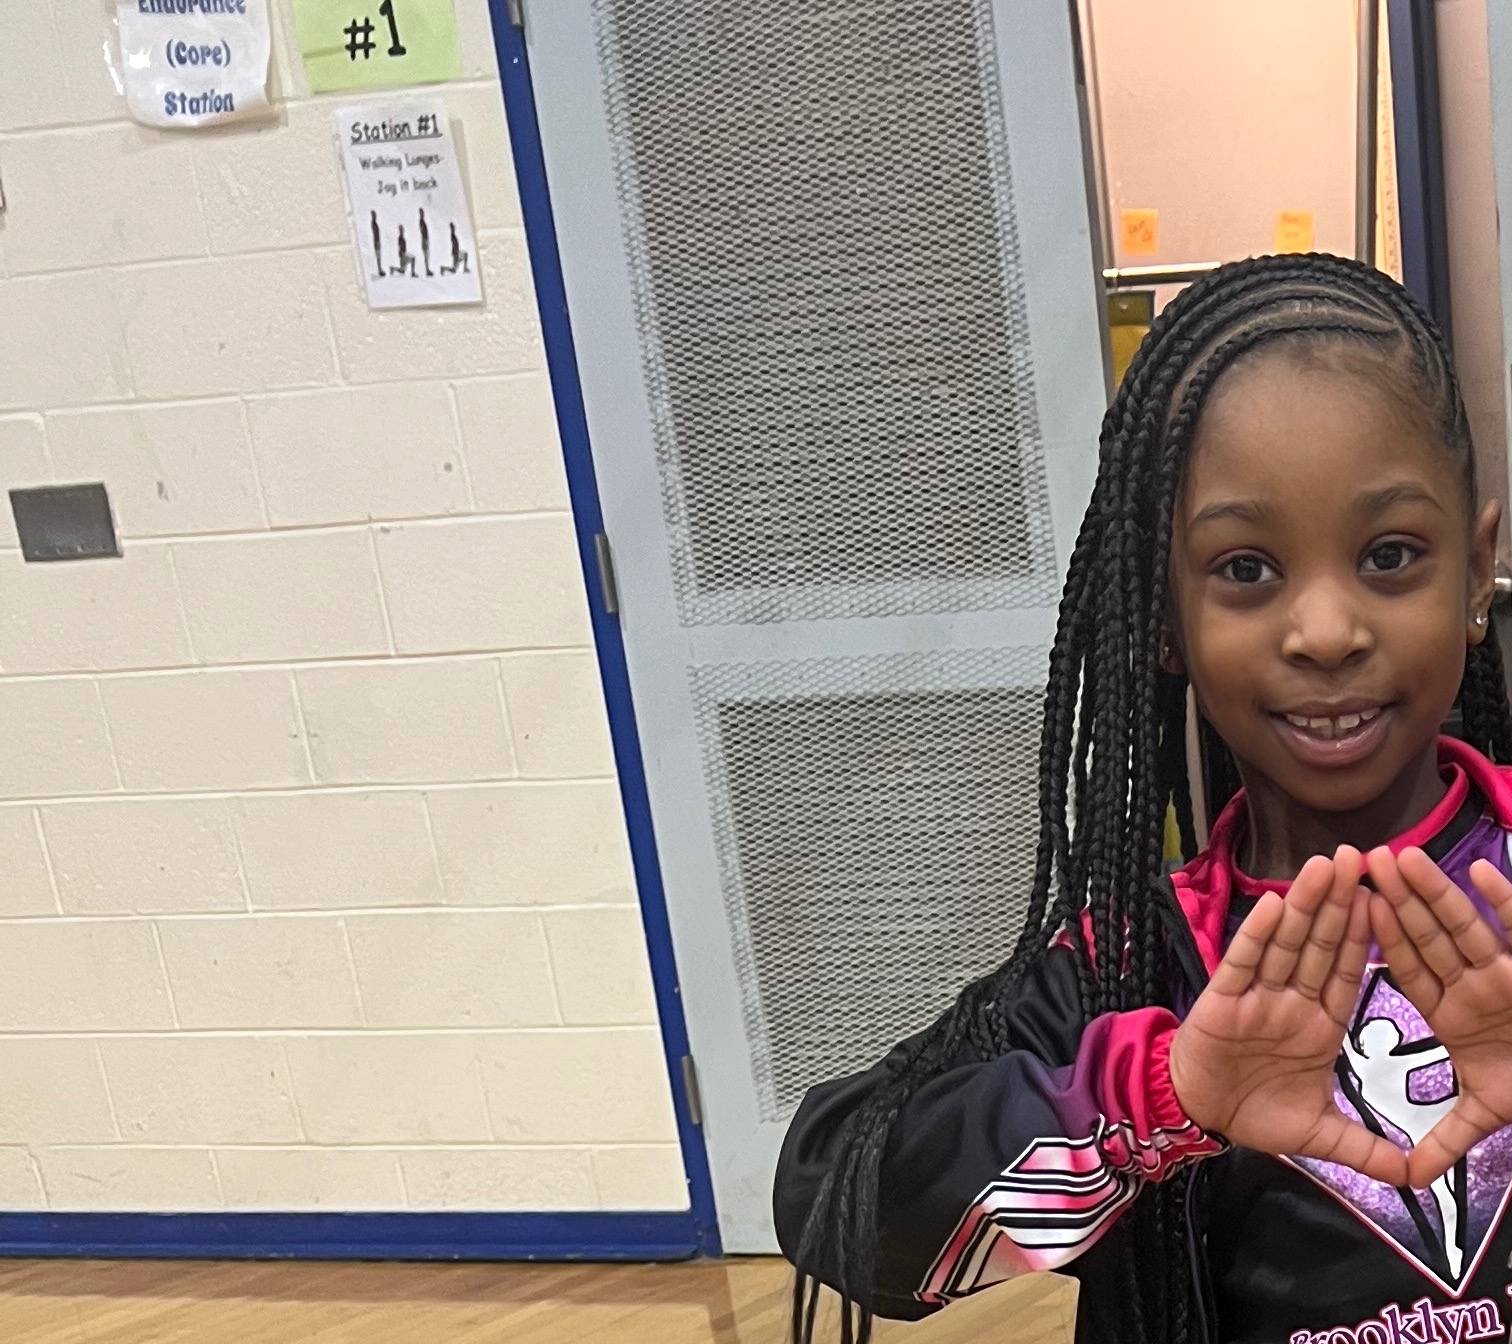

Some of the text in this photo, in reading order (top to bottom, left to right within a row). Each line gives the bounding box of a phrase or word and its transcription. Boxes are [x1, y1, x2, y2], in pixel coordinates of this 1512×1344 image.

[343, 0, 407, 61] #1
[166, 38, 231, 68] (Core)
[164, 89, 235, 116] Station
[351, 113, 440, 143] Station #1
